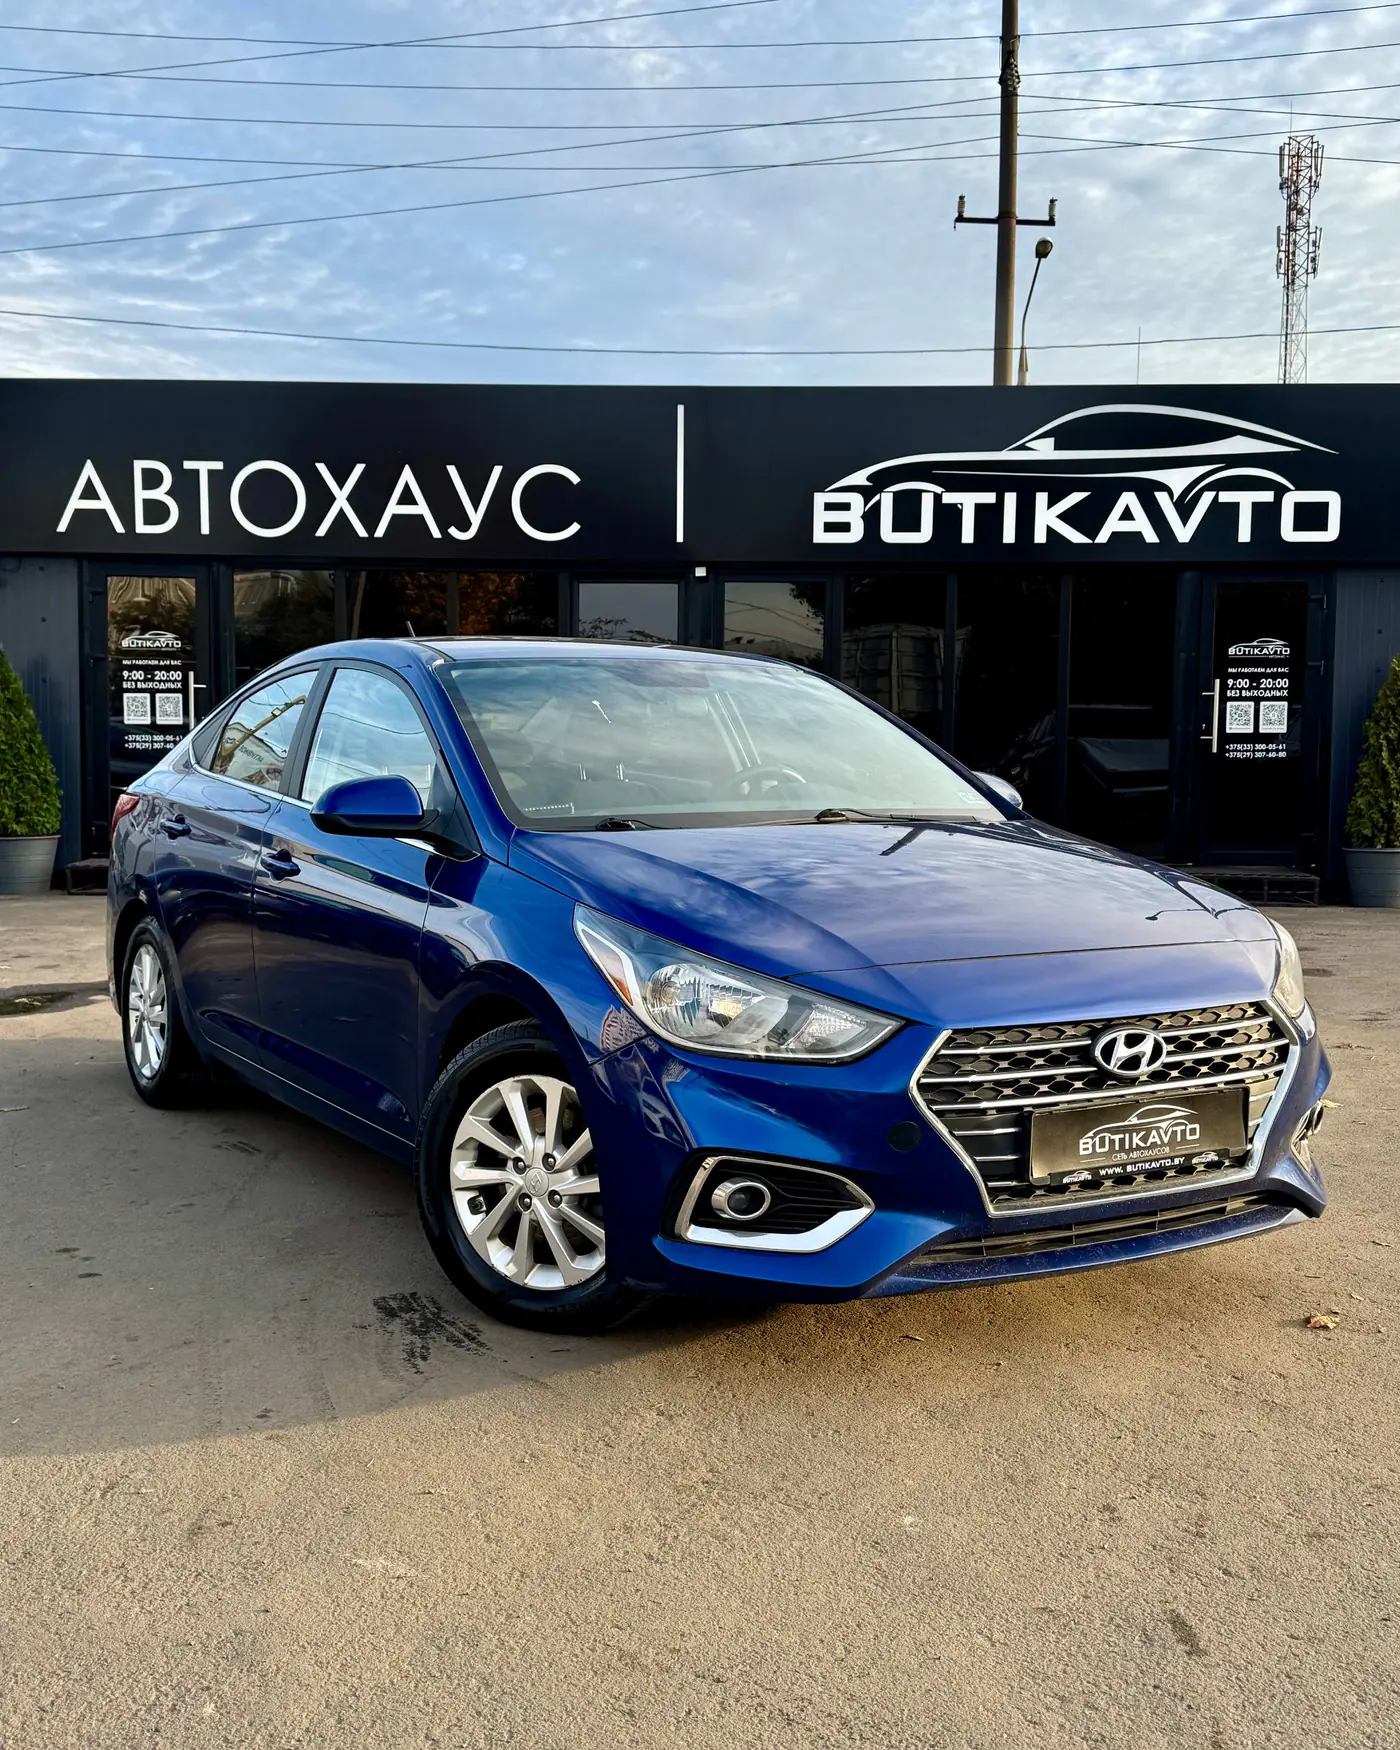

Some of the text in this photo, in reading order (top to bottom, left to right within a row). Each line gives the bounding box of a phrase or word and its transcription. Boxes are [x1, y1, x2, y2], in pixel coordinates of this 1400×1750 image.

[56, 459, 581, 542] АВТОХАУС
[812, 489, 1341, 544] BUTIKAVTO
[122, 640, 182, 648] BUTIKAVTO
[1228, 647, 1290, 655] BUTIKAVTO
[122, 671, 145, 680] 9:00
[154, 671, 182, 680] 20:00
[1227, 679, 1250, 688] 9:00
[1260, 679, 1289, 688] 20:00
[1225, 751, 1254, 759] +375(29)
[1079, 1123, 1200, 1155] BUTIKAVTO
[1111, 1146, 1170, 1161] СЕТЬ АВТОХАУСОВ
[1099, 1157, 1185, 1176] WWW. BUTIKAVTO.BY
